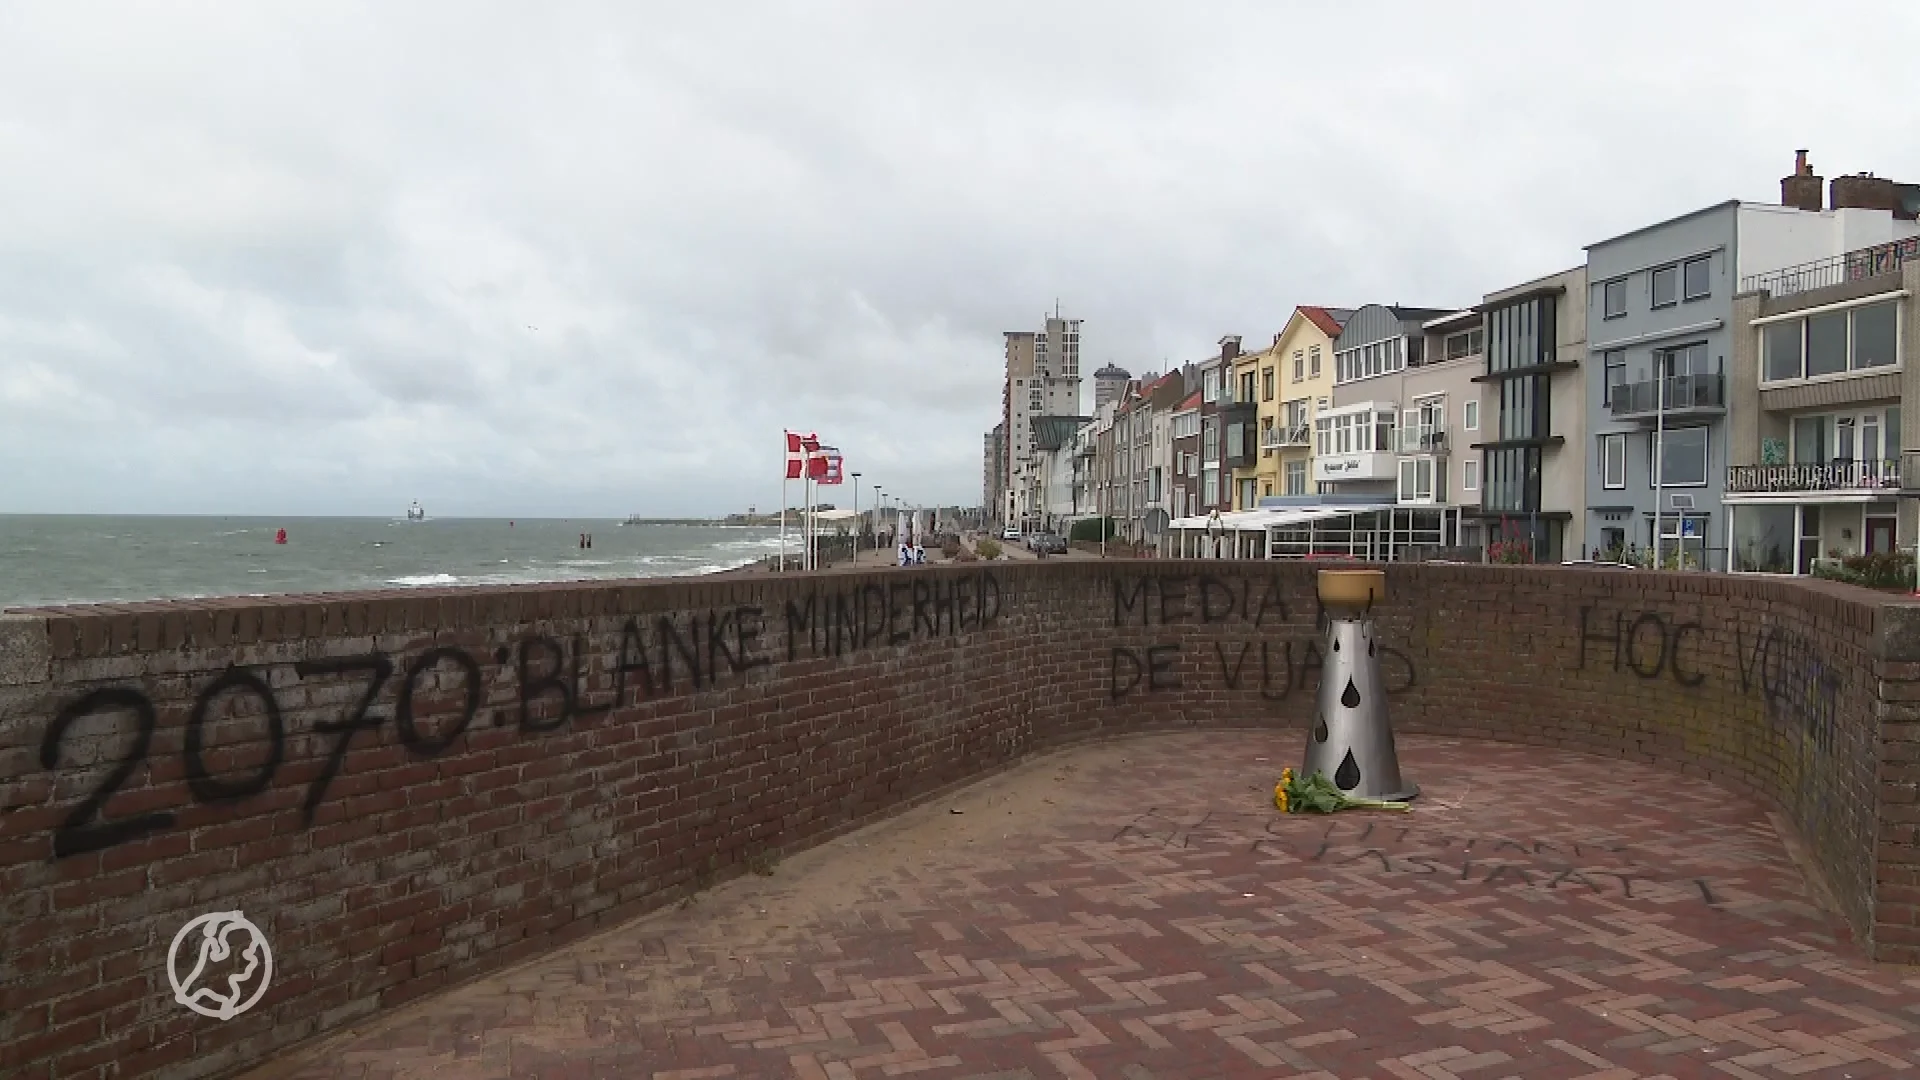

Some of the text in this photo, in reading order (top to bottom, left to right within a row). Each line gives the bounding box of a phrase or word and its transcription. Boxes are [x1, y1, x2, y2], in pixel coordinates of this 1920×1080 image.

[1112, 574, 1289, 628] MEDIA
[517, 606, 770, 733] BLANKE
[786, 570, 1001, 662] MINDERHEID
[1111, 638, 1416, 701] DE VIJAD
[1578, 606, 1705, 688] HOC
